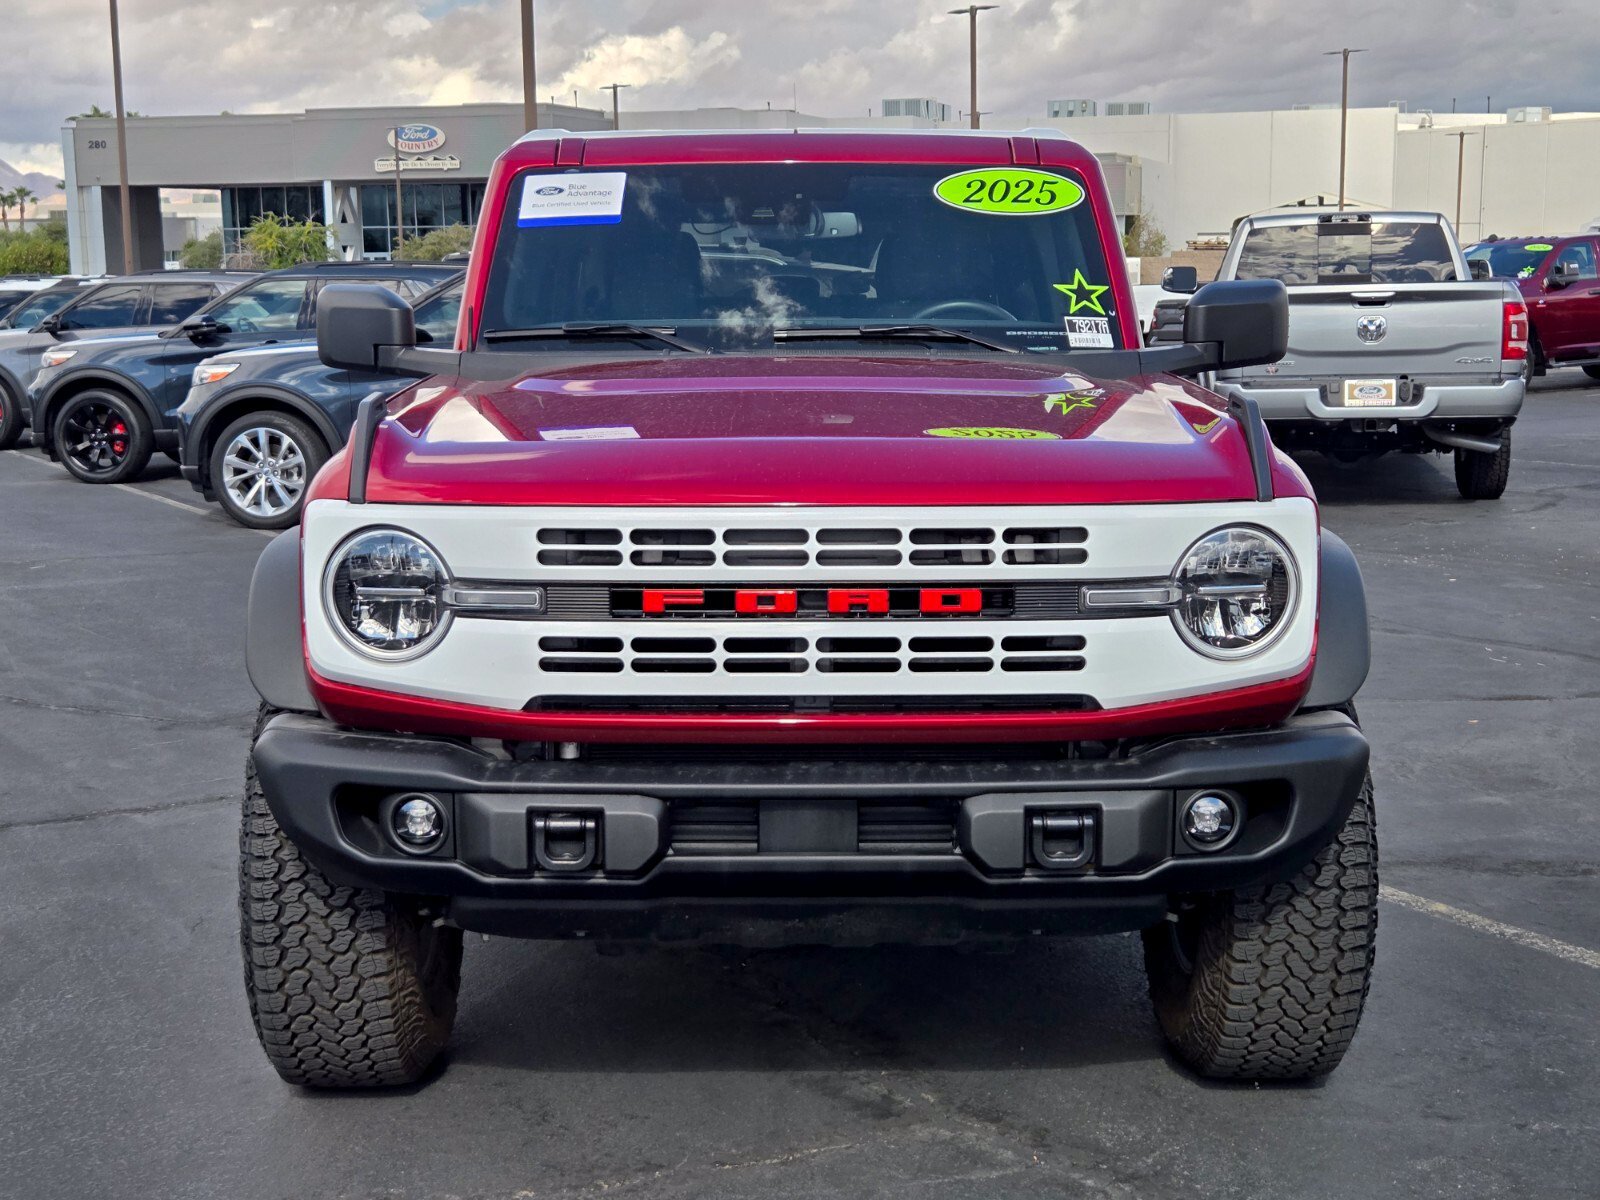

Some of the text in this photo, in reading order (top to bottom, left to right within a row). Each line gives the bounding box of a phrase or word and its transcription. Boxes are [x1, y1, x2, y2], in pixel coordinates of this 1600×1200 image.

[402, 126, 430, 139] Ford
[87, 140, 107, 149] 280
[397, 138, 440, 151] OUNTRY
[567, 189, 613, 197] Advantage
[962, 179, 1059, 206] 2025
[1072, 319, 1110, 334] 79217A
[642, 588, 982, 612] FORD
